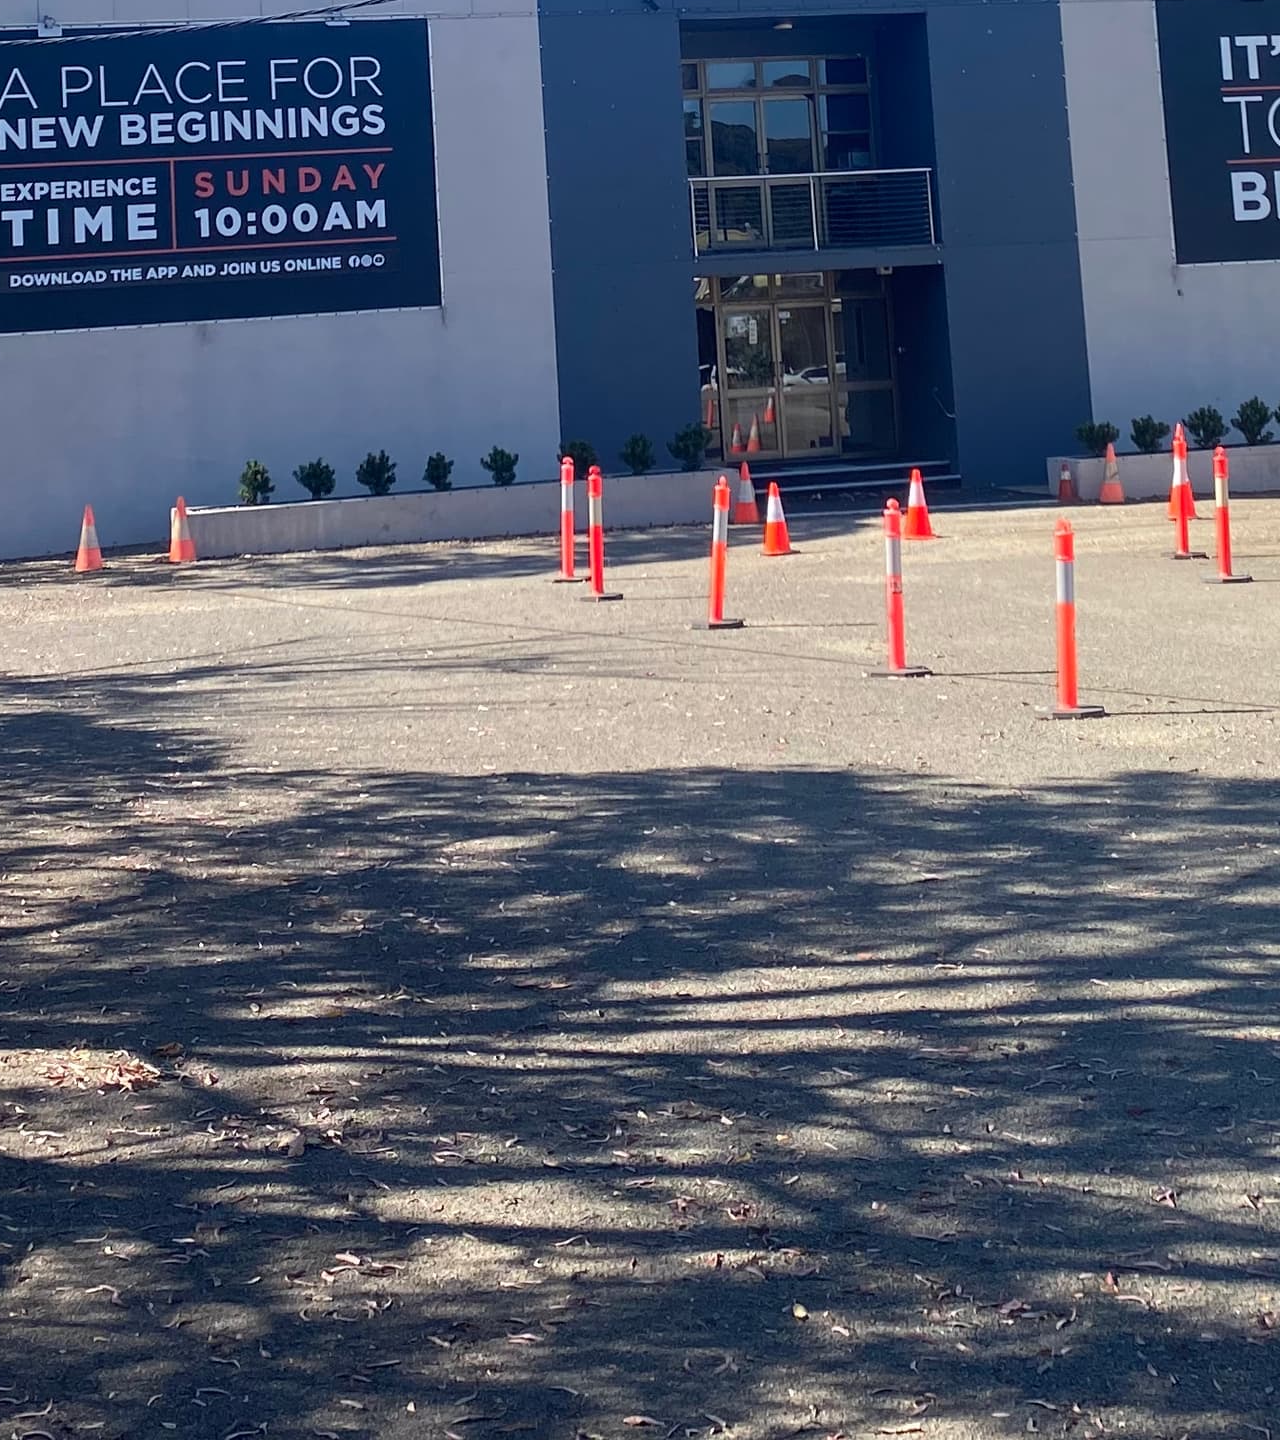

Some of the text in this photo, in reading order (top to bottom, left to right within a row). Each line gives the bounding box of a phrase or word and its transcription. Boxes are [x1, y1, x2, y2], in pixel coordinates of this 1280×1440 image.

[61, 60, 249, 109] PLACE
[270, 56, 384, 101] FOR
[120, 104, 386, 146] BEGINNINGS
[0, 177, 157, 202] EXPERIENCE
[194, 163, 386, 198] SUNDAY
[1, 203, 158, 247] TIME
[194, 199, 387, 238] 10:00AM
[9, 256, 342, 288] DOWNLOAD THE APP AND JOIN US ONLINE
